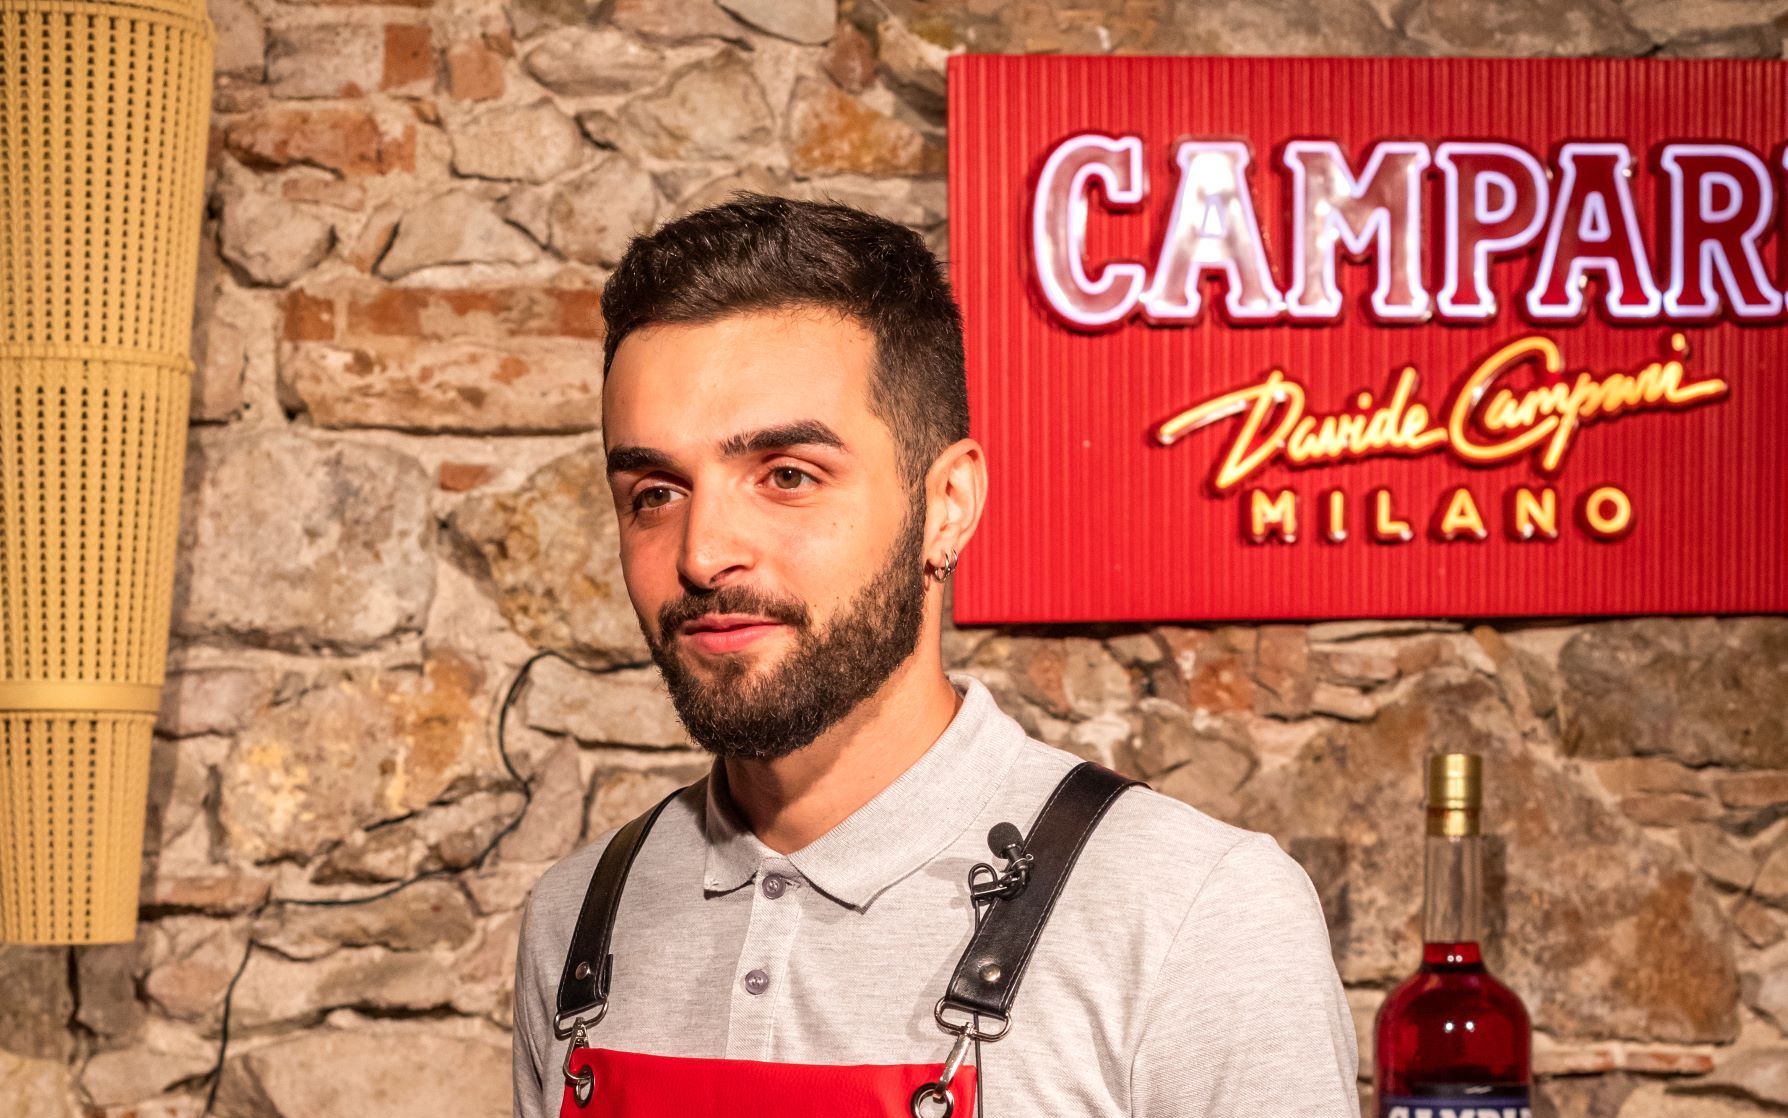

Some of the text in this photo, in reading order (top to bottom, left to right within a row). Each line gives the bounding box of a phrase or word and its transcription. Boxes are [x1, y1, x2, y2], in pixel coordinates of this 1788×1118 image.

[1031, 133, 1788, 326] CAMPAR
[1158, 333, 1728, 488] Davide Campari
[1251, 487, 1633, 543] MILANO
